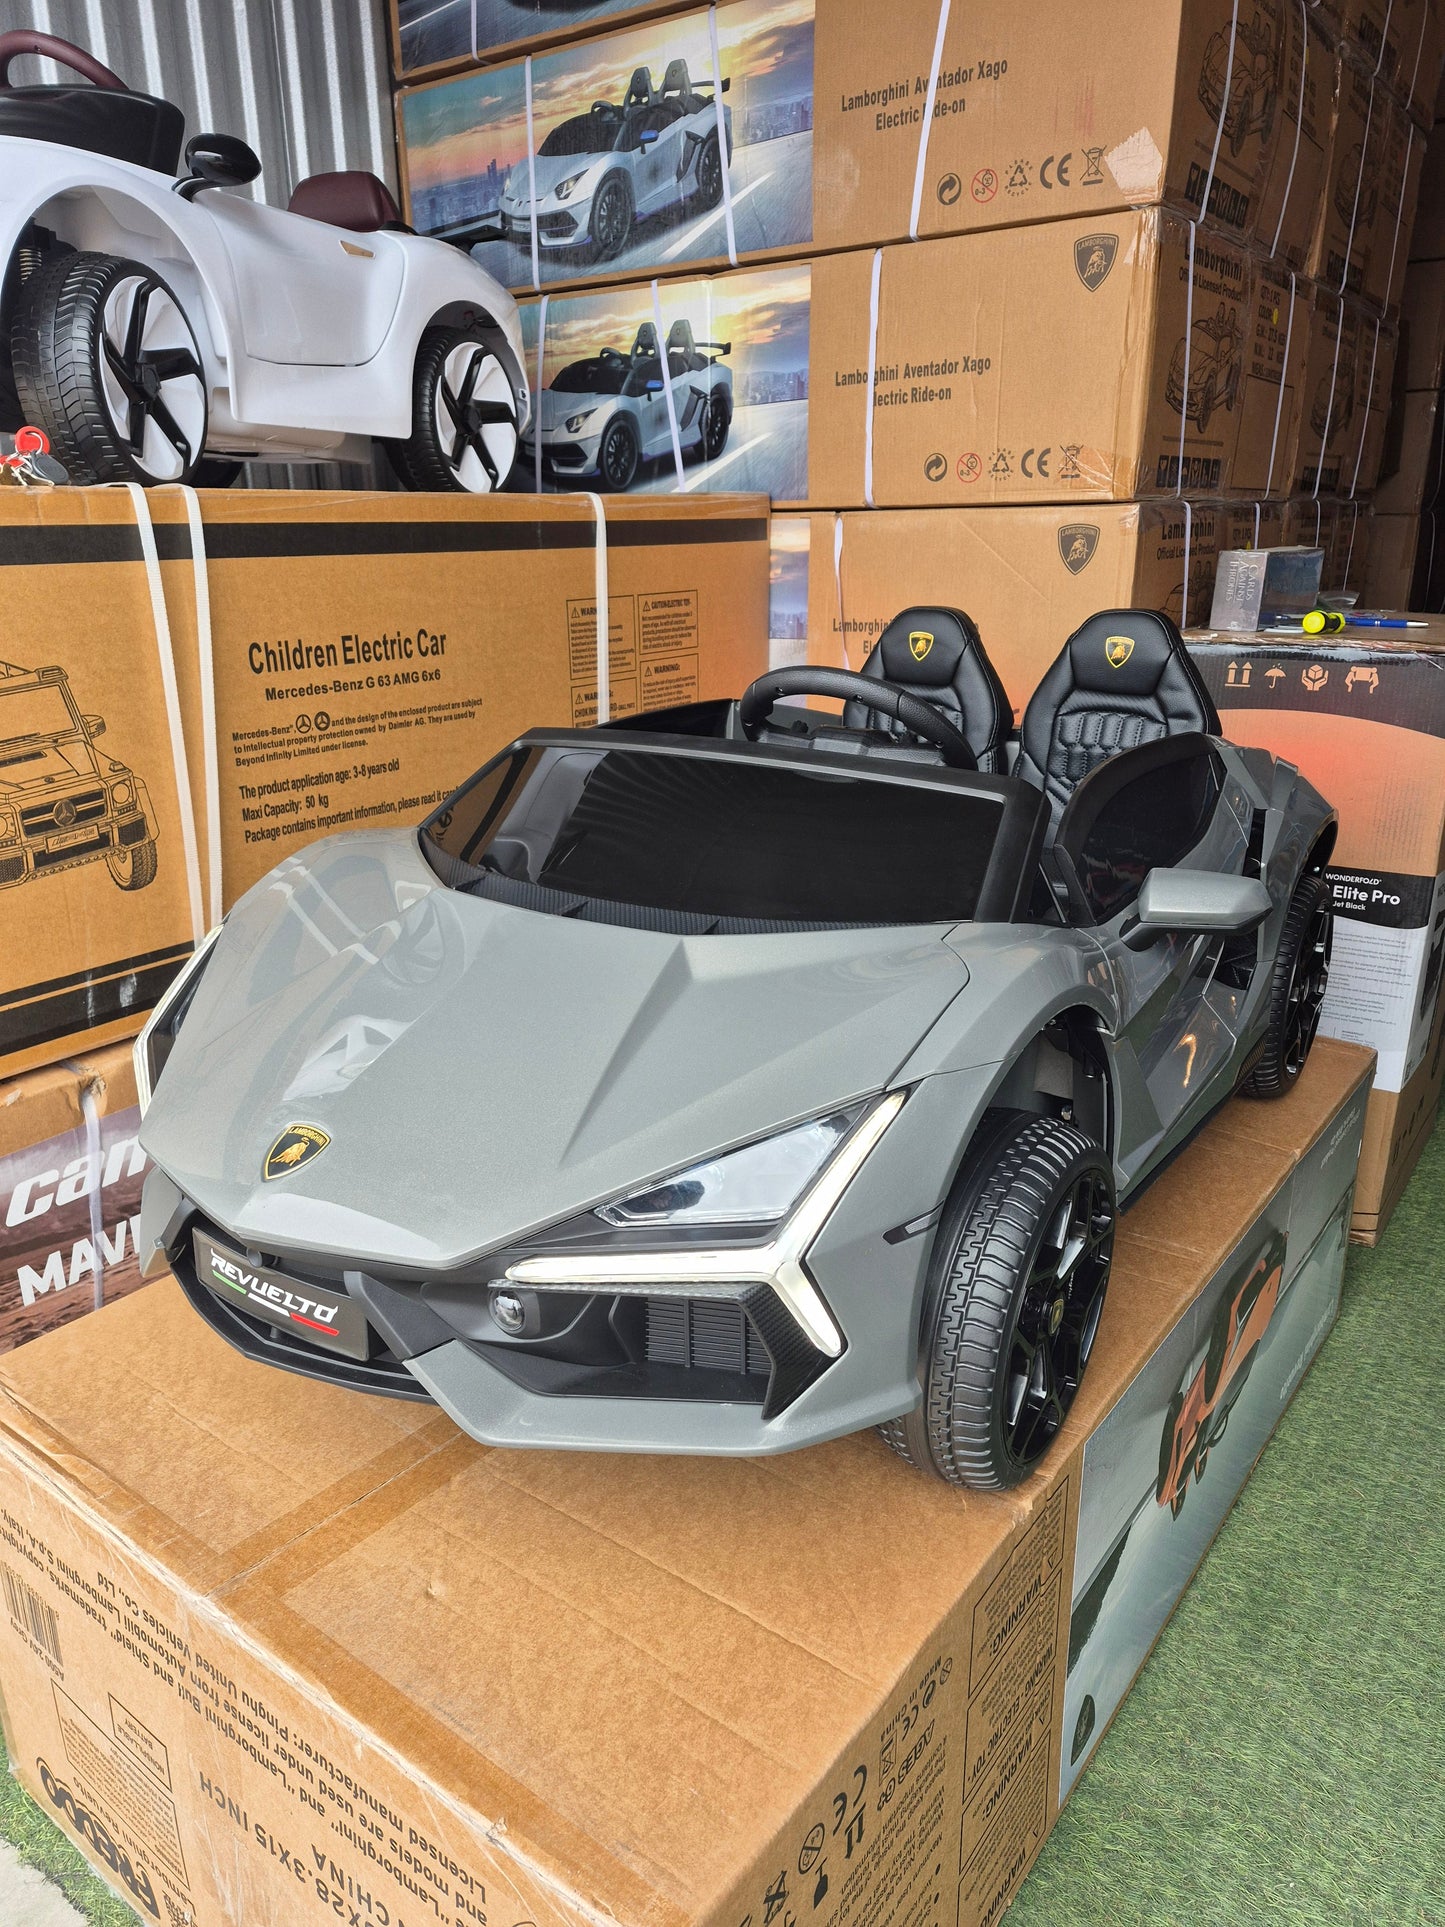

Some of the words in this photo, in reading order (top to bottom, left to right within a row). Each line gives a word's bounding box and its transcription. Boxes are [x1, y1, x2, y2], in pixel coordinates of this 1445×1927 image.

[841, 79, 910, 112] Lamborghini
[914, 66, 974, 95] Avntador
[977, 59, 1008, 82] Xago
[875, 106, 920, 131] Electric
[922, 98, 966, 120] de-on
[1184, 236, 1242, 281] Lmborghini
[835, 364, 899, 387] Lamboghini
[903, 358, 960, 380] Aventador
[962, 355, 991, 375] Xago
[873, 388, 909, 406] lectric
[910, 386, 952, 404] Ride-on
[1161, 515, 1215, 541] Lambrghini
[1246, 564, 1259, 602] CARDS
[248, 638, 339, 675] Children
[340, 630, 414, 665] Electric
[416, 628, 447, 658] Car
[265, 678, 365, 701] Mercedes-Benz
[366, 675, 376, 688] G
[377, 674, 391, 687] 63
[393, 670, 420, 686] AMG
[421, 668, 442, 682] 6x6
[234, 745, 243, 754] to
[287, 733, 317, 748] property
[318, 728, 354, 742] protection
[354, 725, 377, 736] owned
[378, 724, 387, 733] by
[388, 719, 413, 731] Daimler
[428, 715, 443, 724] They
[443, 714, 453, 722] are
[453, 711, 468, 720] used
[468, 710, 476, 719] by
[331, 718, 345, 727] and
[345, 716, 357, 725] the
[357, 713, 380, 724] design
[380, 711, 387, 720] of
[387, 710, 398, 719] the
[398, 705, 427, 717] enclosed
[427, 703, 451, 714] product
[461, 698, 483, 708] subject
[235, 754, 265, 767] Beyond
[266, 750, 293, 762] Infinity
[293, 745, 320, 757] Limited
[321, 742, 341, 752] under
[239, 784, 257, 800] The
[257, 779, 291, 800] product
[291, 771, 334, 792] application
[335, 769, 352, 784] age:
[352, 764, 367, 779] 3-8
[366, 762, 388, 780] years
[387, 757, 400, 773] old
[242, 804, 263, 822] Maxi
[264, 799, 303, 819] Capacity:
[305, 794, 316, 810] 50
[318, 793, 329, 809] kg
[244, 827, 281, 844] Package
[281, 818, 316, 836] contains
[316, 809, 354, 829] important
[354, 800, 398, 821] information,
[397, 796, 420, 813] please
[420, 790, 436, 806] read
[436, 789, 442, 801] it
[1332, 884, 1369, 901] Elite
[1371, 889, 1401, 906] Pro
[1332, 900, 1345, 908] Jet
[1345, 901, 1367, 911] Black
[210, 1247, 339, 1324] REVUELTO
[46, 1566, 108, 1632] trademarks,
[56, 1557, 121, 1624] Lamborghini
[97, 1571, 116, 1599] Ltd
[142, 1609, 192, 1661] Vehicles
[989, 1573, 1041, 1657] WARNING:
[123, 1614, 186, 1678] Automobili
[152, 1661, 174, 1688] and
[189, 1670, 220, 1708] from
[195, 1652, 238, 1700] United
[919, 1655, 941, 1690] Made
[177, 1682, 201, 1715] Bull
[241, 1690, 289, 1743] Pinghu
[223, 1699, 270, 1750] license
[880, 1703, 907, 1743] China
[987, 1695, 1020, 1757] ELECTRIC
[273, 1743, 314, 1785] under
[897, 1718, 934, 1785] AGES
[915, 1742, 942, 1785] contains
[971, 1749, 986, 1783] TOY
[293, 1733, 403, 1833] manufacturer:
[876, 1776, 896, 1812] 6+
[900, 1764, 933, 1820] packaging
[924, 1759, 946, 1795] Please
[981, 1732, 1032, 1822] WARNING:
[199, 1770, 249, 1833] INCH
[299, 1786, 326, 1818] and
[318, 1778, 354, 1818] used
[882, 1783, 914, 1835] important
[907, 1790, 923, 1821] keep
[35, 1756, 161, 1920] FREDDO
[358, 1813, 384, 1842] are
[881, 1818, 898, 1848] must
[895, 1819, 906, 1839] the
[121, 1830, 196, 1917] Lamborghini
[389, 1837, 449, 1897] models
[408, 1827, 486, 1905] Licensed
[903, 1852, 915, 1876] Not
[912, 1831, 942, 1882] Maximum
[310, 1843, 390, 1927] CHINA
[851, 1884, 863, 1905] the
[873, 1867, 890, 1899] must
[895, 1881, 911, 1910] User
[455, 1891, 488, 1927] and
[838, 1904, 849, 1926] toy
